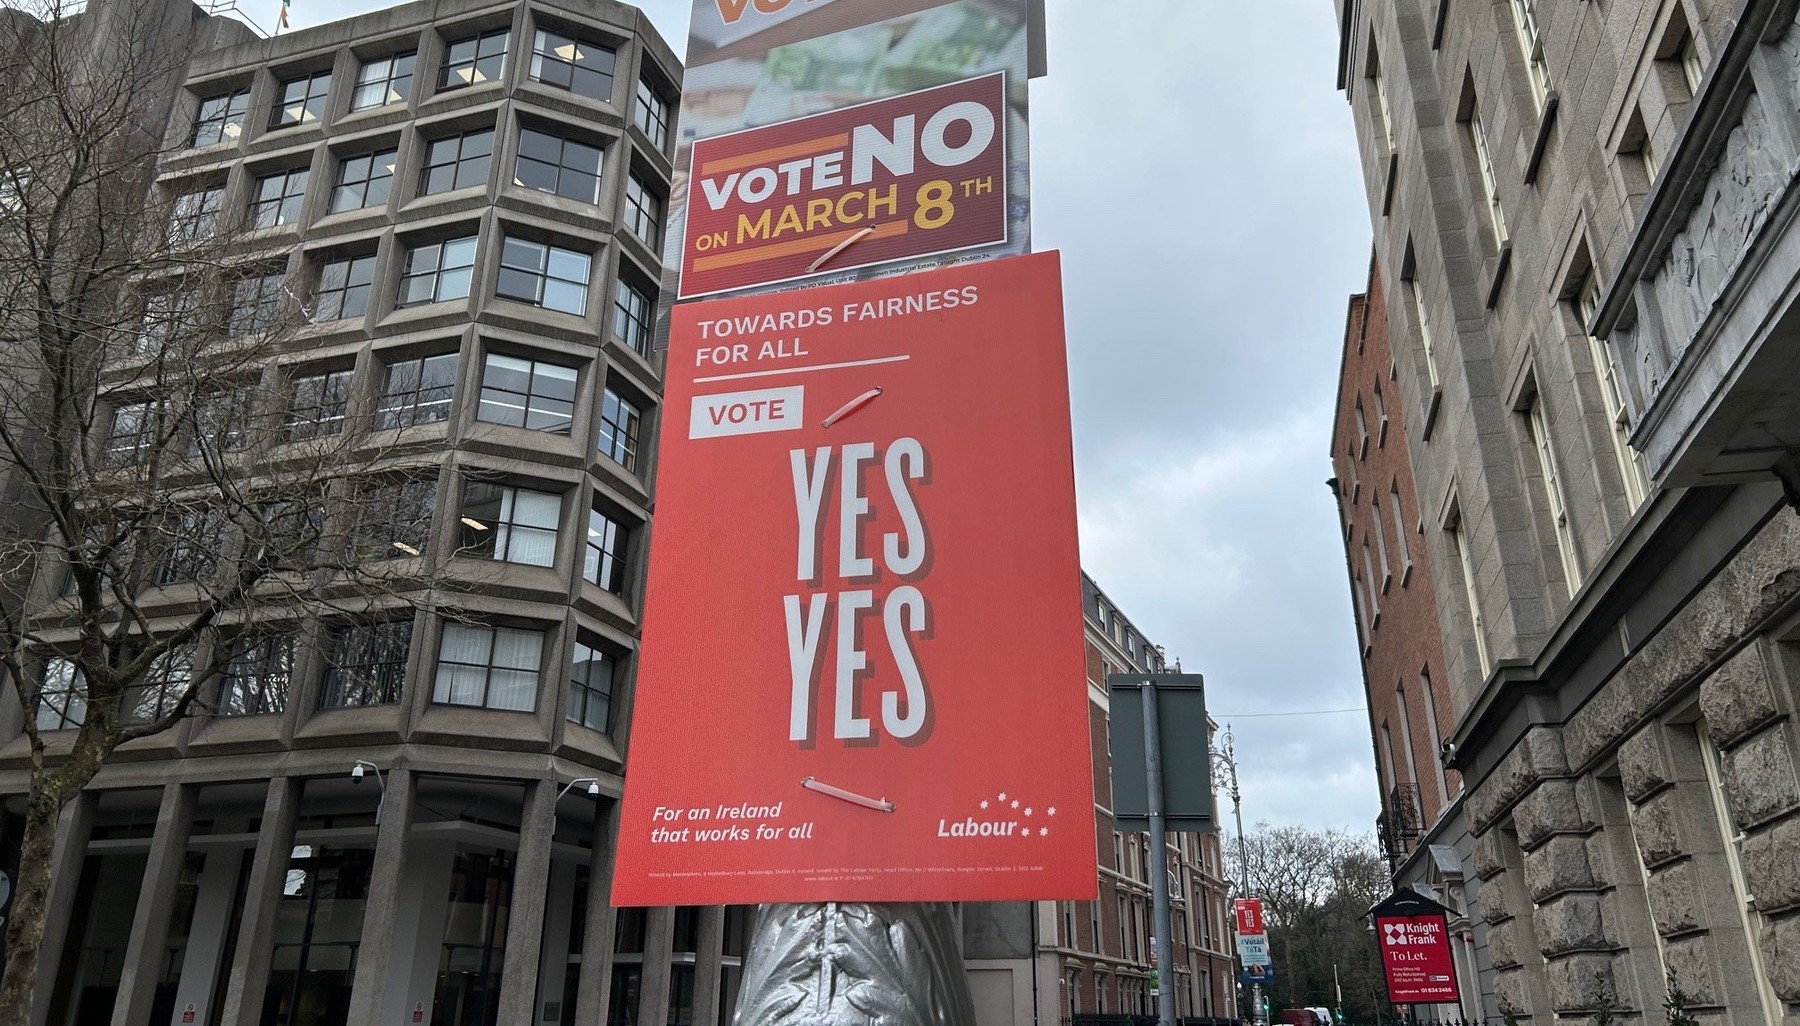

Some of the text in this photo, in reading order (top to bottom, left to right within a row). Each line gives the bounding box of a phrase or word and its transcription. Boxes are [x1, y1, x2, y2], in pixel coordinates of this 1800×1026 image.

[700, 101, 995, 210] VOTE NO
[695, 229, 728, 251] ON
[736, 183, 898, 244] MARCH
[697, 285, 979, 339] TOWARDS FAIRNESS
[696, 337, 809, 367] FOR ALL
[708, 399, 785, 426] VOTE
[789, 437, 928, 581] YES
[783, 585, 928, 741] YES
[652, 801, 783, 821] For an Ireland
[651, 822, 814, 843] that works for all
[937, 818, 1017, 838] Labour
[1406, 922, 1440, 935] Knight
[1408, 934, 1437, 945] Frank
[1390, 950, 1428, 961] To Let.
